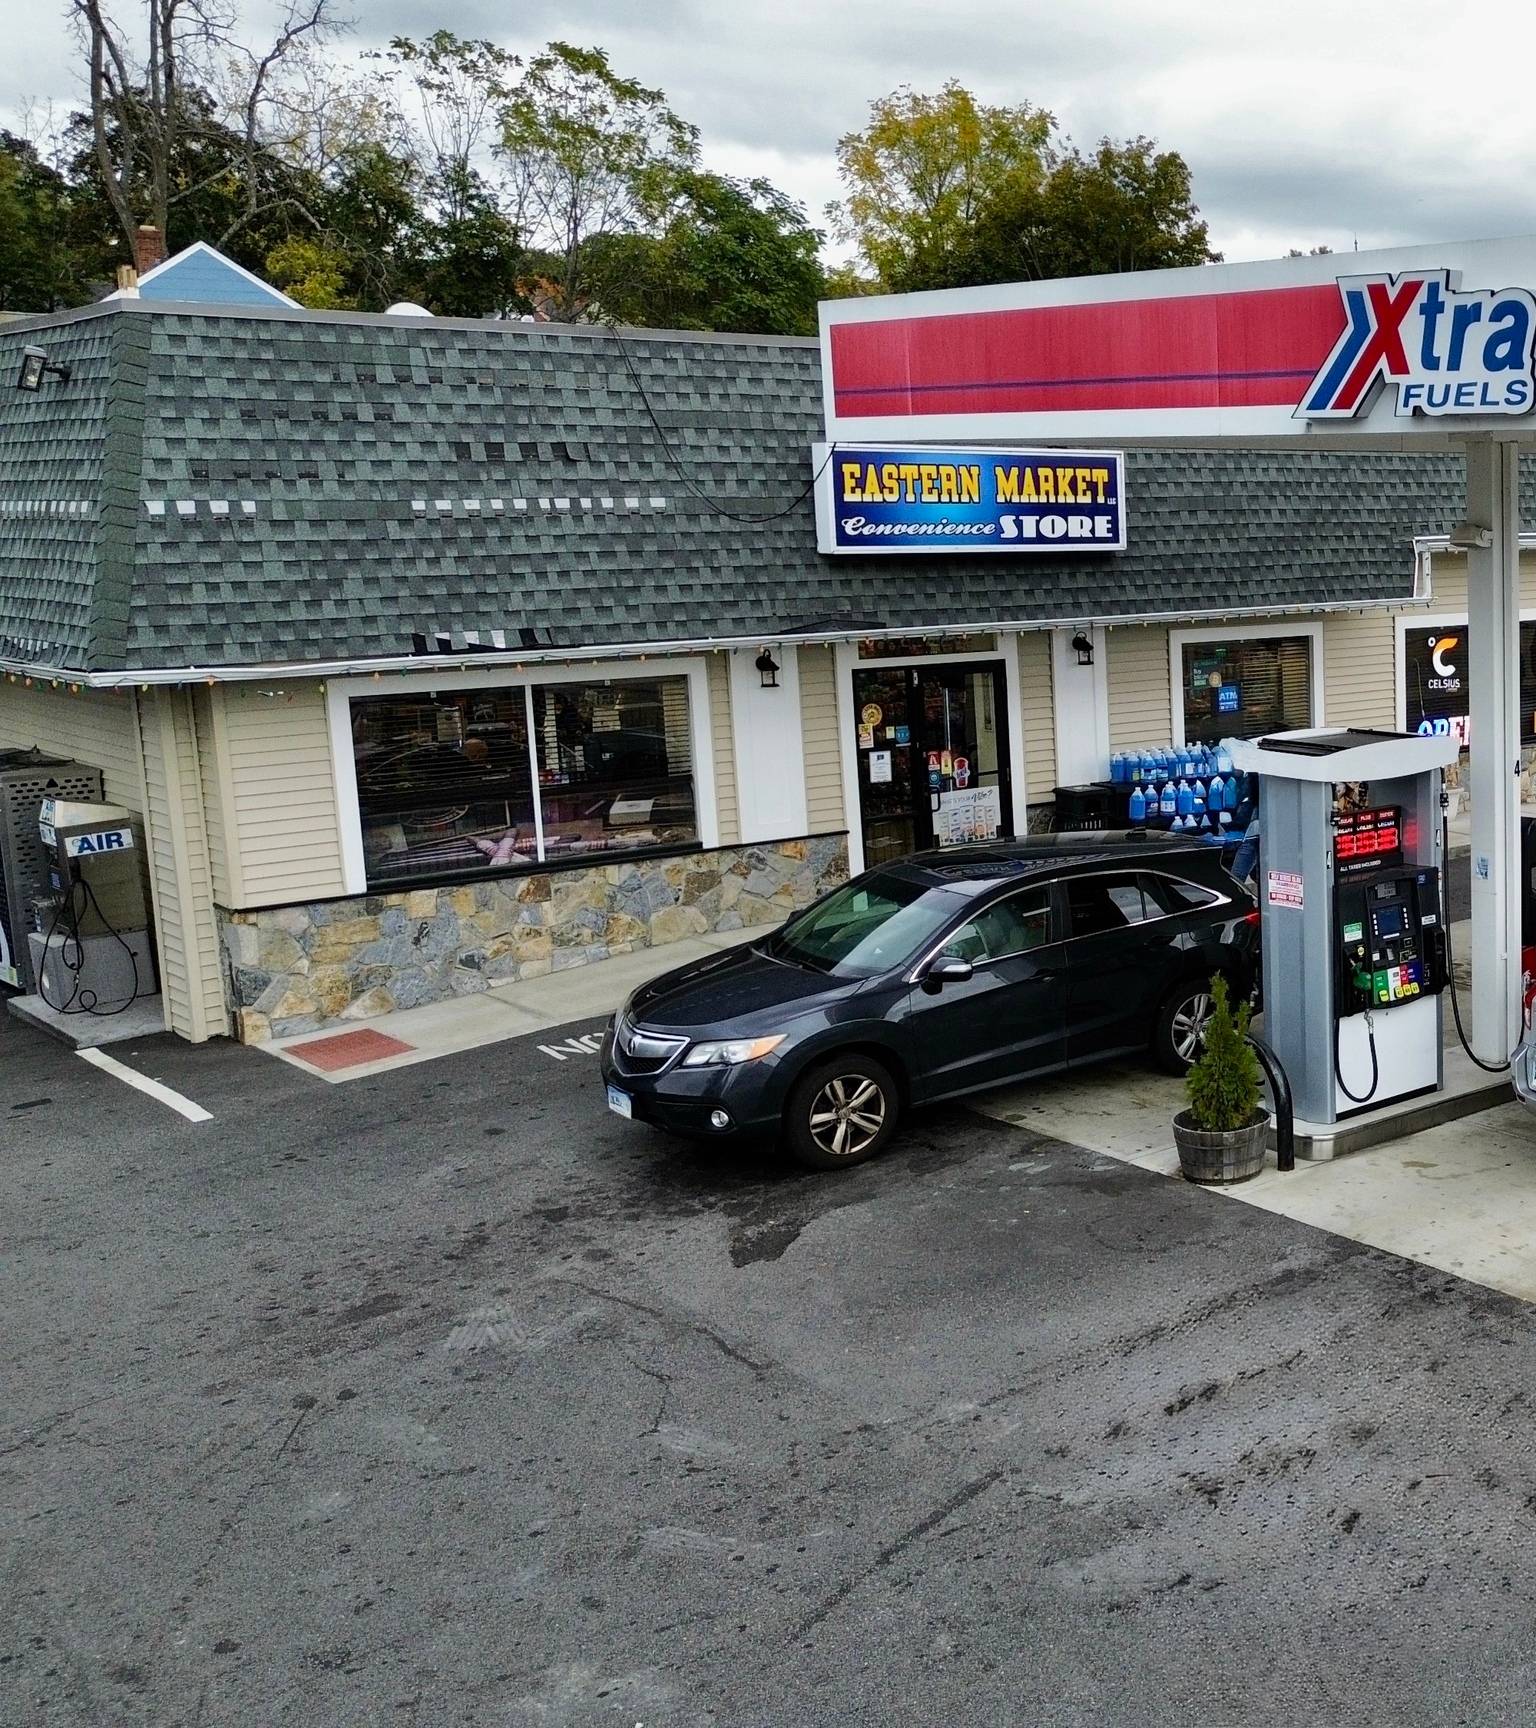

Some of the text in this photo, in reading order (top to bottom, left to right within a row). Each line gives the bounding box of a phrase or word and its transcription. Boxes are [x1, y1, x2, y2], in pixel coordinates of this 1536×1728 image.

[1318, 280, 1530, 410] Xtra
[1402, 379, 1529, 409] FUELS
[841, 462, 981, 503] EASTERN
[994, 466, 1109, 505] MARKET
[841, 514, 1113, 539] Convenience STORE
[1219, 691, 1238, 701] ATM
[1428, 679, 1461, 690] CELSIUS
[1513, 759, 1520, 777] 4
[77, 832, 124, 854] AIR
